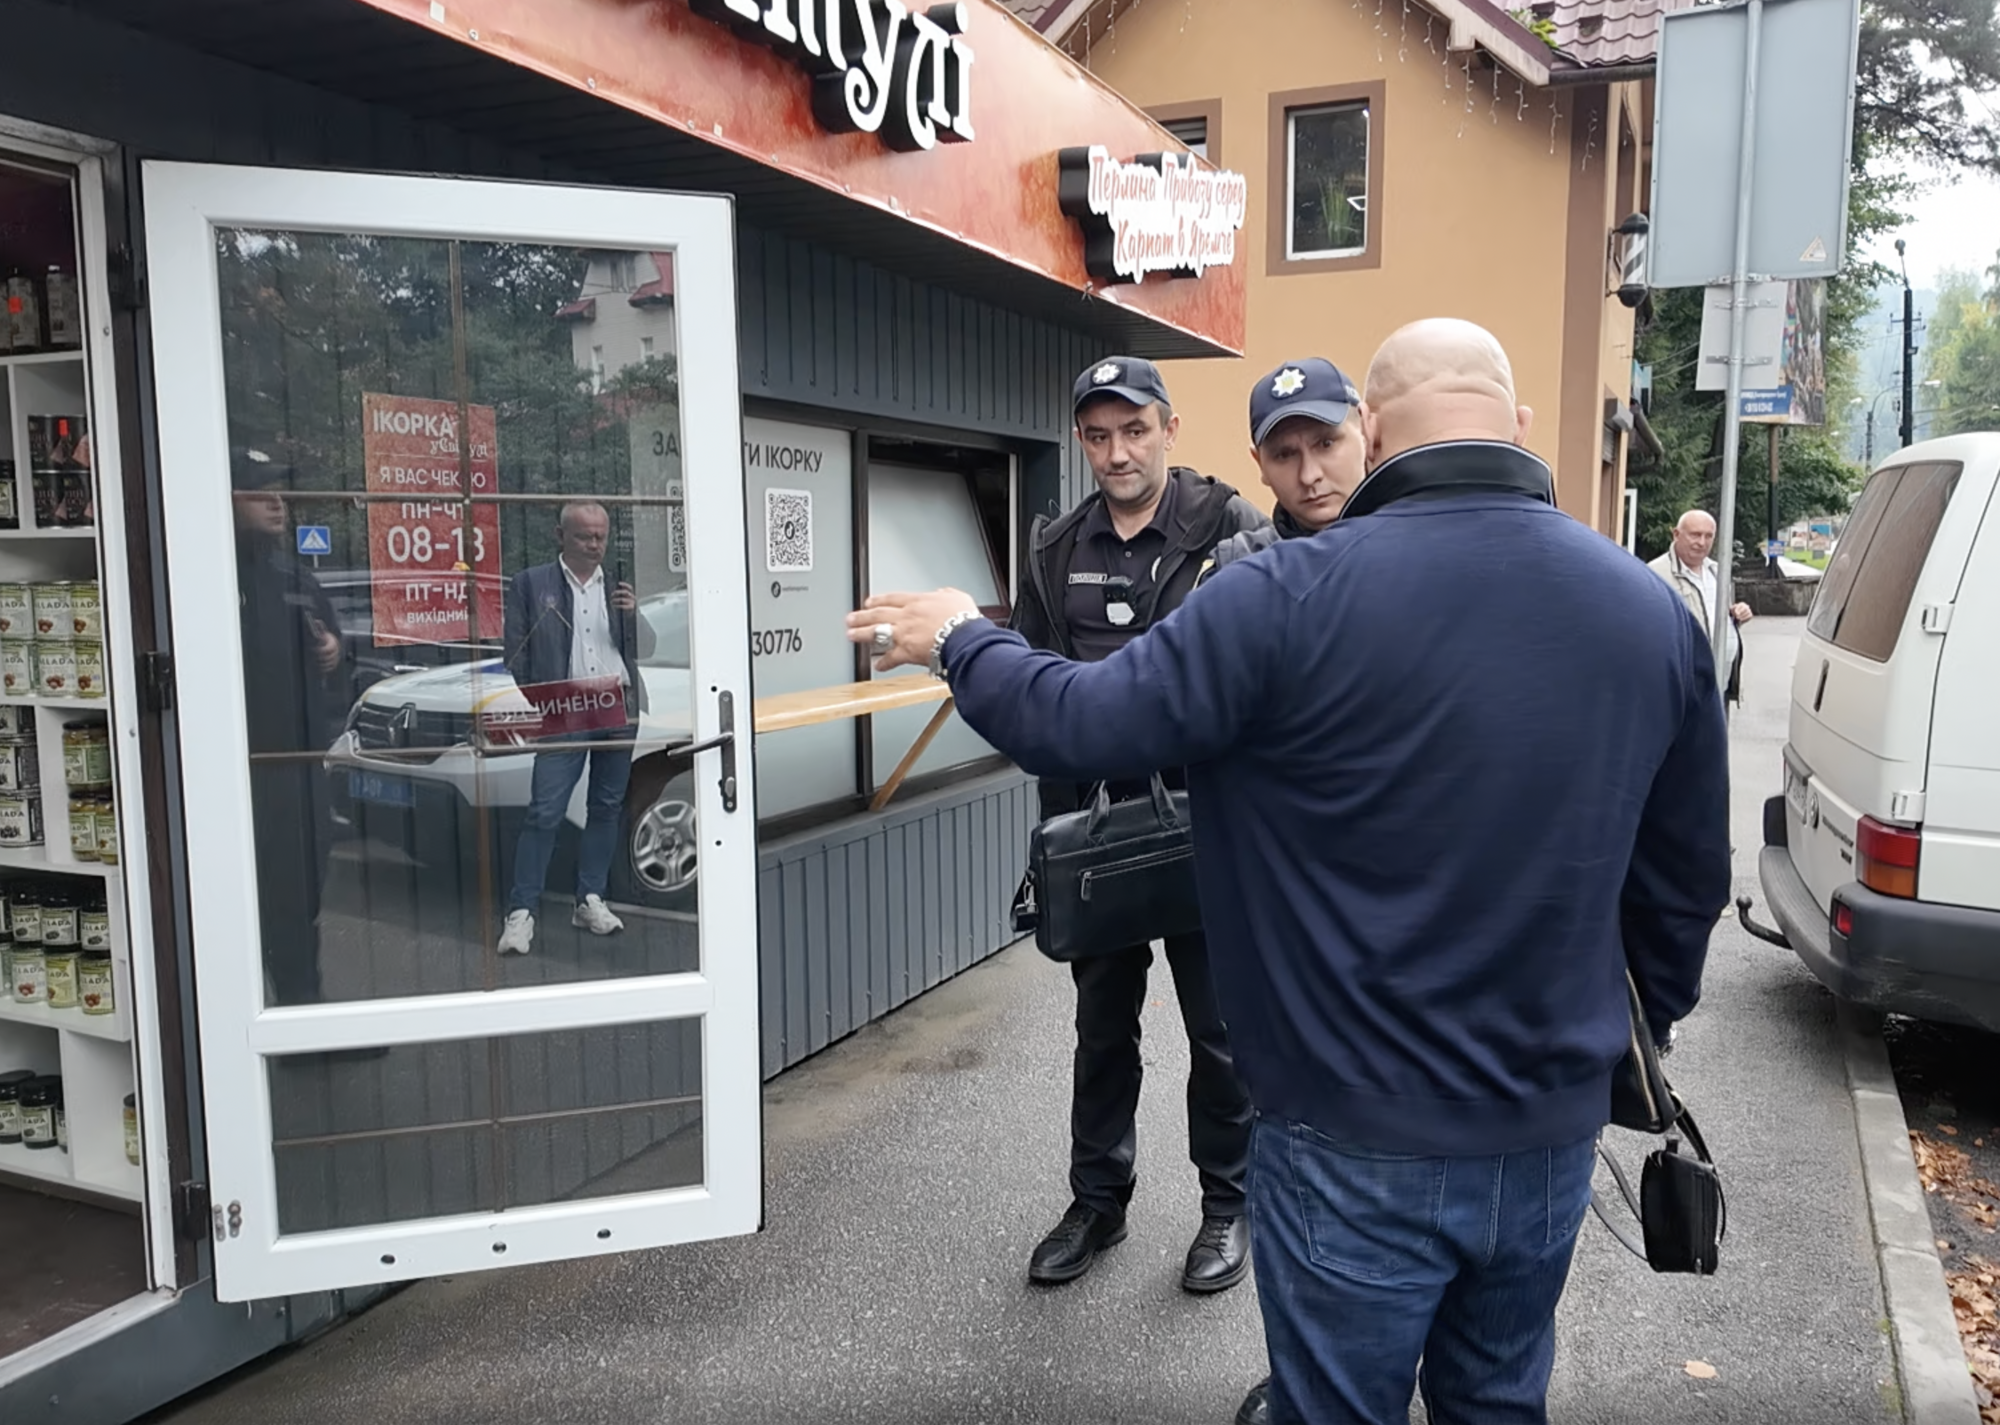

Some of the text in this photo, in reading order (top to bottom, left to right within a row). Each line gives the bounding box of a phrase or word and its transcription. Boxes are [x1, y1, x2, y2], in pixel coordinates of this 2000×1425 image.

[1092, 156, 1244, 220] Перлина Привозу серед
[1116, 215, 1232, 278] Карпат в Яремче
[373, 409, 455, 439] ІКОРКА
[765, 444, 823, 474] ІКОРКУ
[380, 466, 487, 489] Я ВАС ЧЕКЮ
[752, 627, 803, 657] 30776
